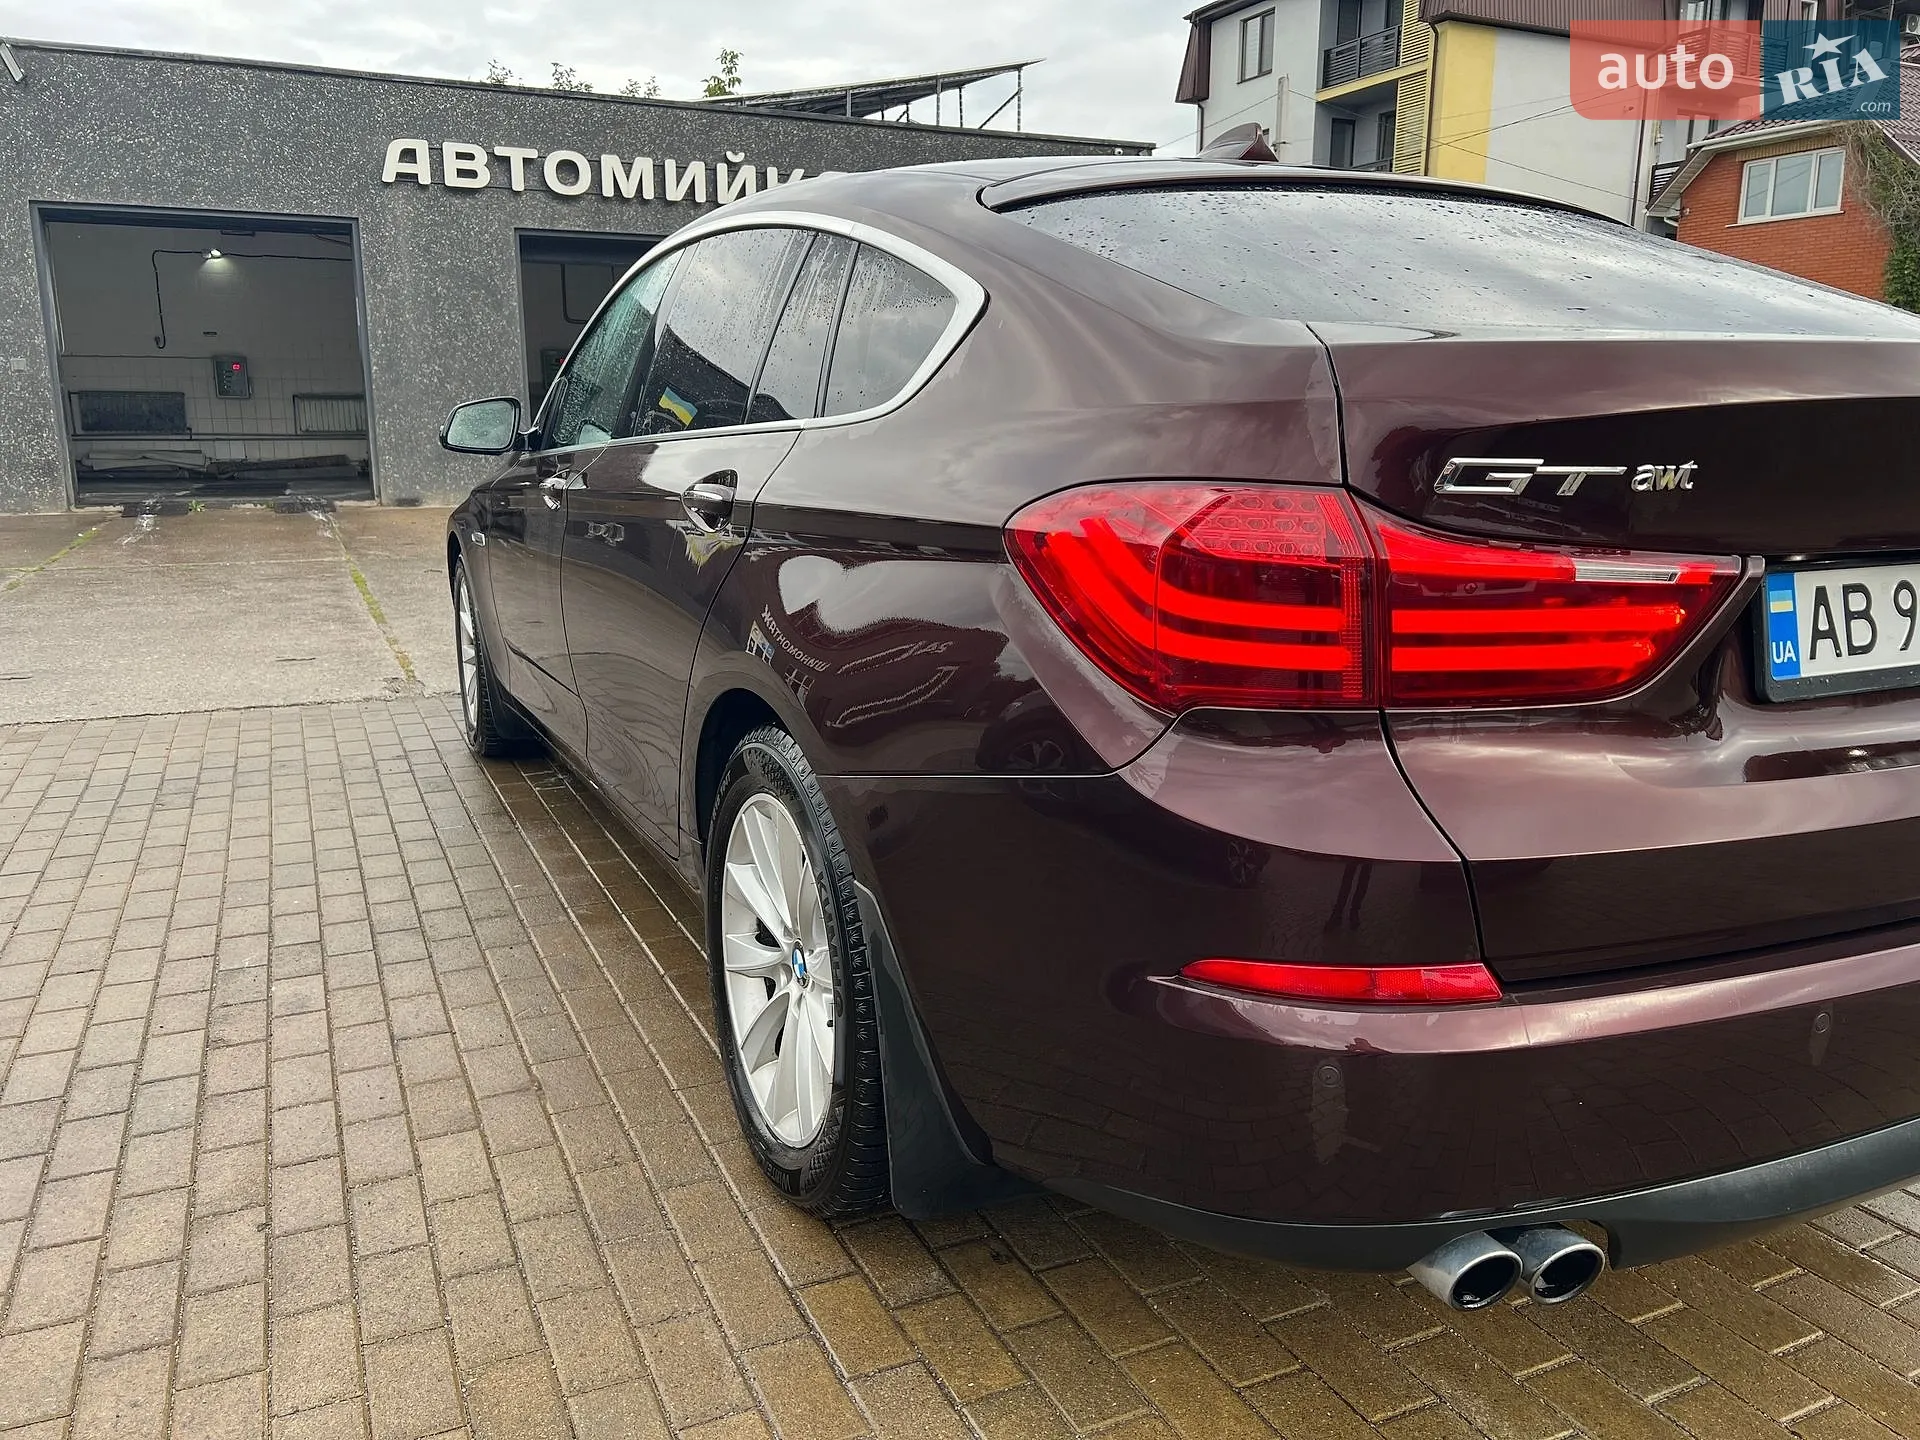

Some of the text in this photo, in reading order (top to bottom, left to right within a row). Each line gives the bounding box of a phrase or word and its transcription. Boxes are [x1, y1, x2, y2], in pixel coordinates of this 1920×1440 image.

[1434, 457, 1628, 496] GT
[1809, 579, 1918, 660] AB 9
[1771, 640, 1797, 663] UA
